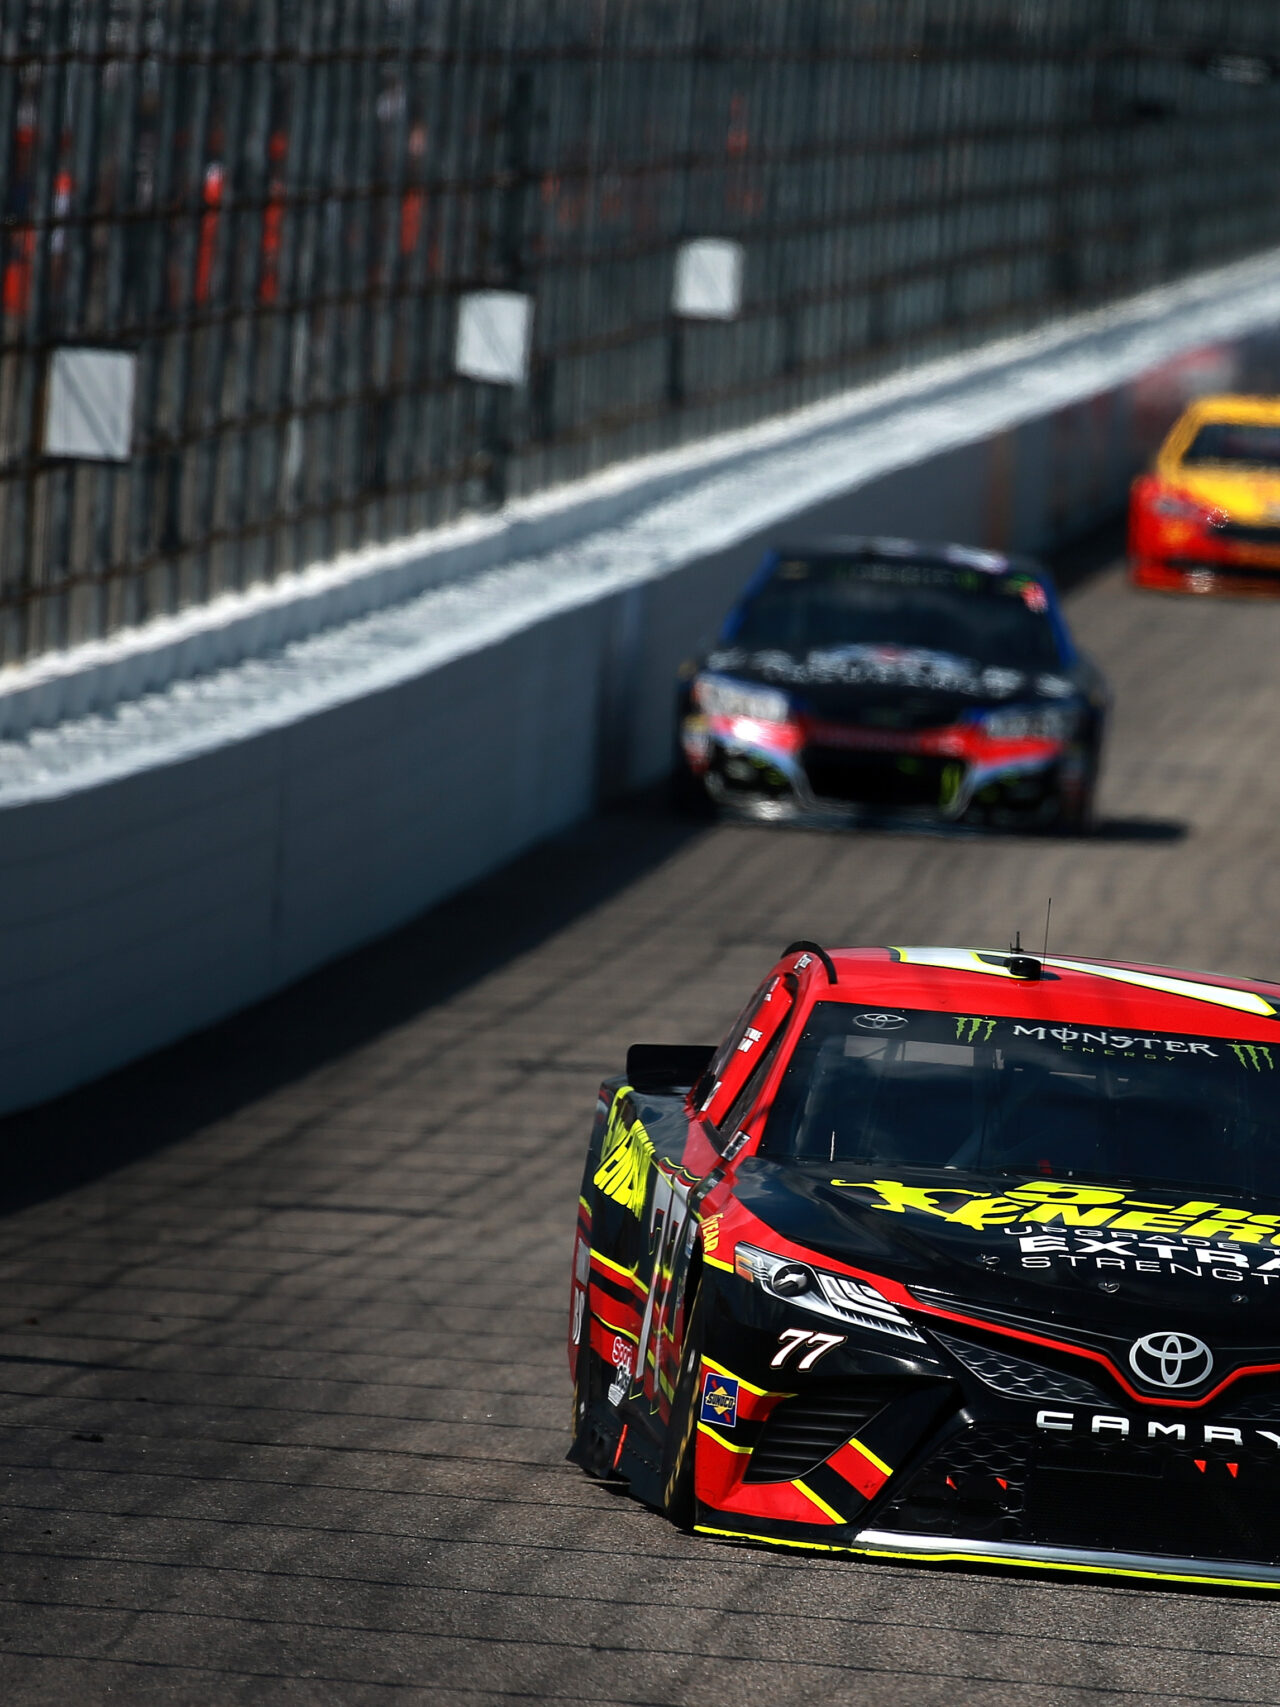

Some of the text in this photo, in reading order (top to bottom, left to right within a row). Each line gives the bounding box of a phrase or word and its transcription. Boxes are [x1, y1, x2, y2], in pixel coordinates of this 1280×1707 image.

[1013, 1024, 1219, 1058] MONSTER
[1062, 1045, 1176, 1061] ENERGY
[1003, 1225, 1241, 1252] UPGRADE
[770, 1328, 848, 1372] 77
[705, 1392, 736, 1409] SUNOCO
